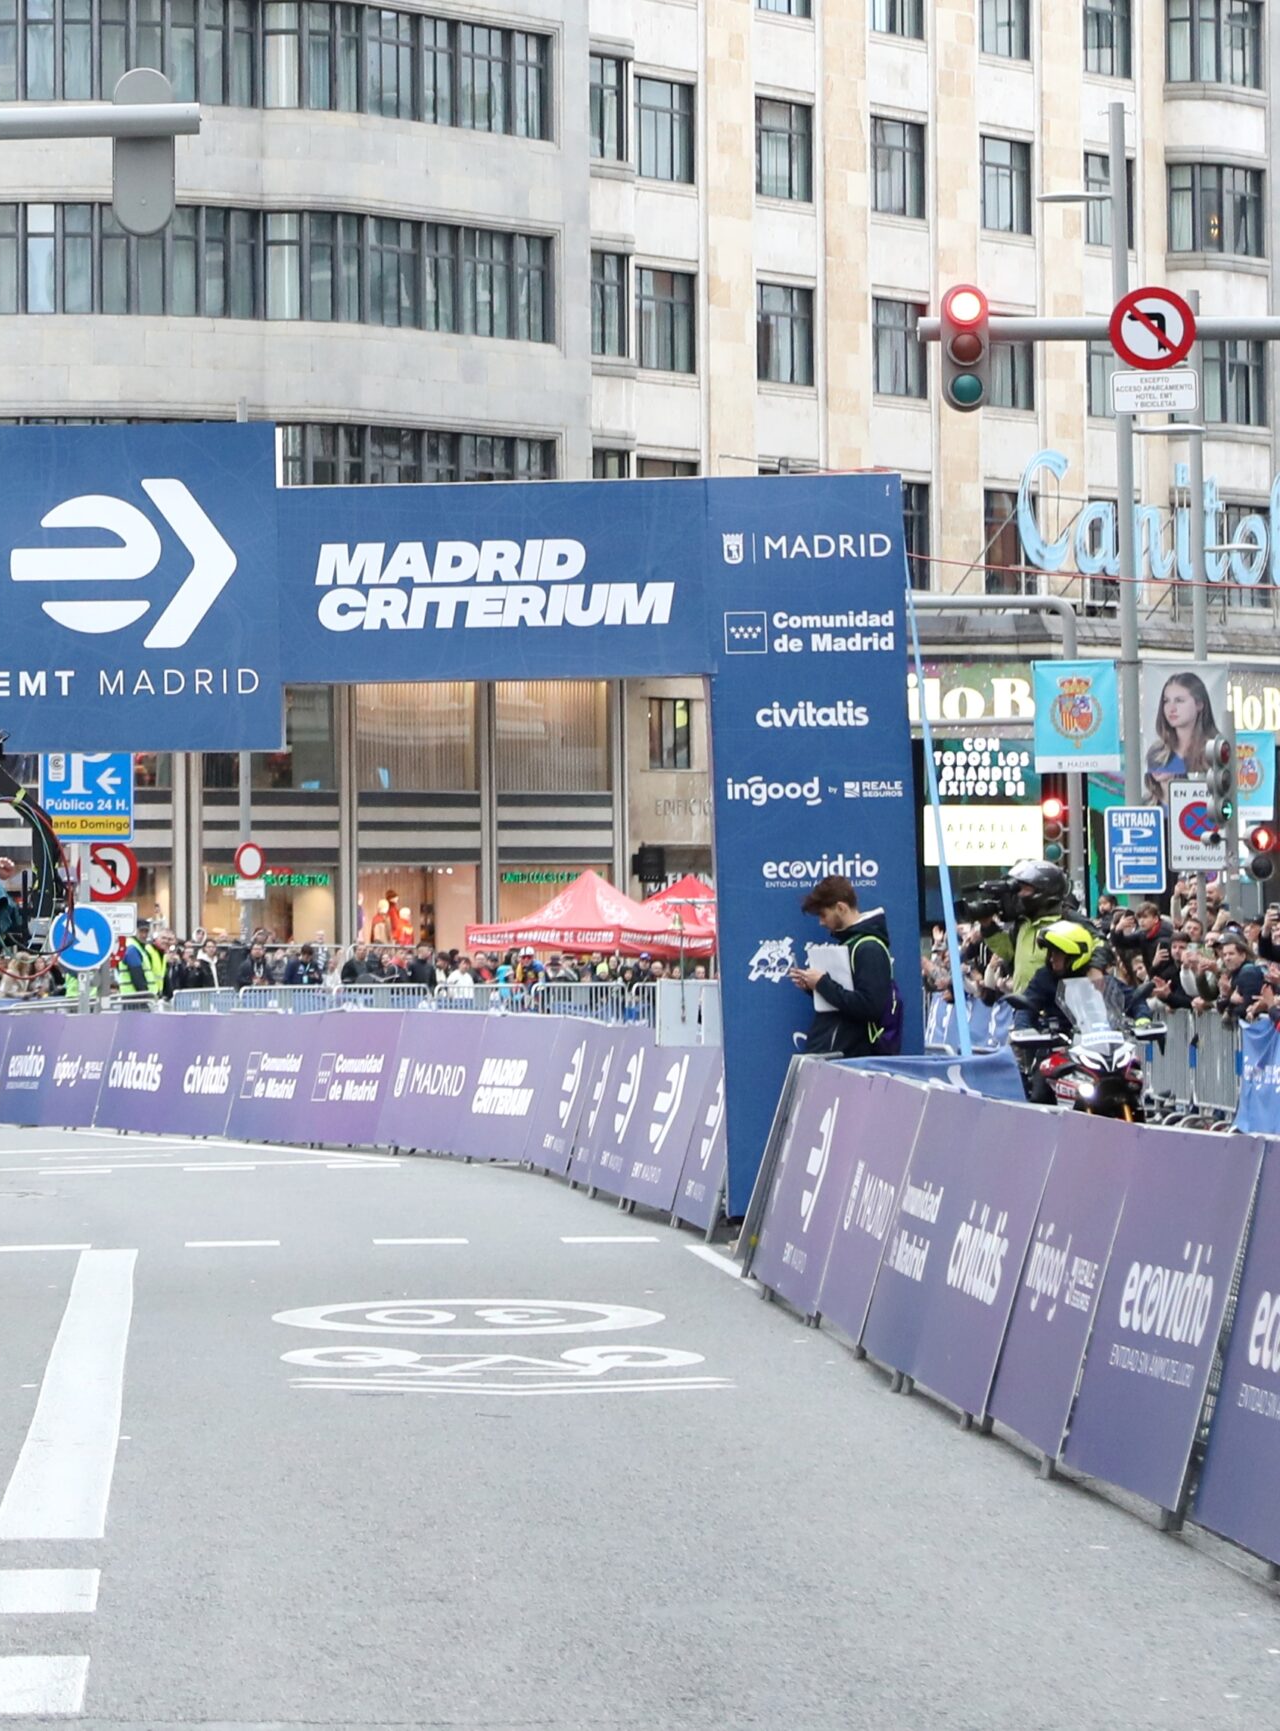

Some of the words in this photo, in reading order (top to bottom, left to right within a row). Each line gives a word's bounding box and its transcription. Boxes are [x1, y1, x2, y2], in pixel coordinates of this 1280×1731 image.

[763, 532, 892, 560] MADRID
[314, 537, 586, 586] MADRID
[317, 581, 675, 633] CRITERIUM
[772, 610, 895, 630] Comunidad
[773, 632, 803, 653] de
[809, 632, 895, 652] Madrid
[98, 667, 260, 696] MADRID
[755, 701, 869, 728] civitatis
[962, 737, 1001, 752] CON
[933, 751, 991, 767] TODOS
[997, 751, 1030, 767] LOS
[941, 766, 1023, 782] GRANDES
[828, 785, 838, 795] by
[862, 781, 903, 791] REALE
[862, 790, 904, 798] SEGUROS
[938, 779, 999, 797] ÉXITOS
[1004, 781, 1026, 797] DE
[1173, 790, 1188, 798] EN
[46, 799, 94, 811] Público
[97, 800, 113, 811] 24
[115, 799, 130, 811] H.
[50, 820, 78, 830] anto
[80, 819, 130, 832] Domingo
[1112, 812, 1157, 828] ENTRADA
[1117, 828, 1154, 846] P
[762, 853, 880, 879] ecovidrio
[765, 880, 798, 889] ENTIDAD
[799, 879, 812, 888] SIN
[851, 879, 878, 888] LUCRO
[108, 1050, 163, 1092] civitatis
[260, 1052, 303, 1073] Comunidad
[335, 1054, 384, 1074] Comunidad
[478, 1057, 529, 1087] MADRID
[183, 1055, 231, 1094] civitatis
[409, 1061, 467, 1097] MADRID
[254, 1079, 265, 1098] de
[265, 1079, 297, 1100] Madrid
[329, 1080, 341, 1101] de
[342, 1080, 380, 1102] Madrid
[471, 1086, 535, 1116] CRITERIUM
[855, 1171, 896, 1241] MADRID
[946, 1200, 1010, 1306] civitatis
[1119, 1240, 1214, 1347] ecovidrio
[365, 1307, 567, 1325] 30
